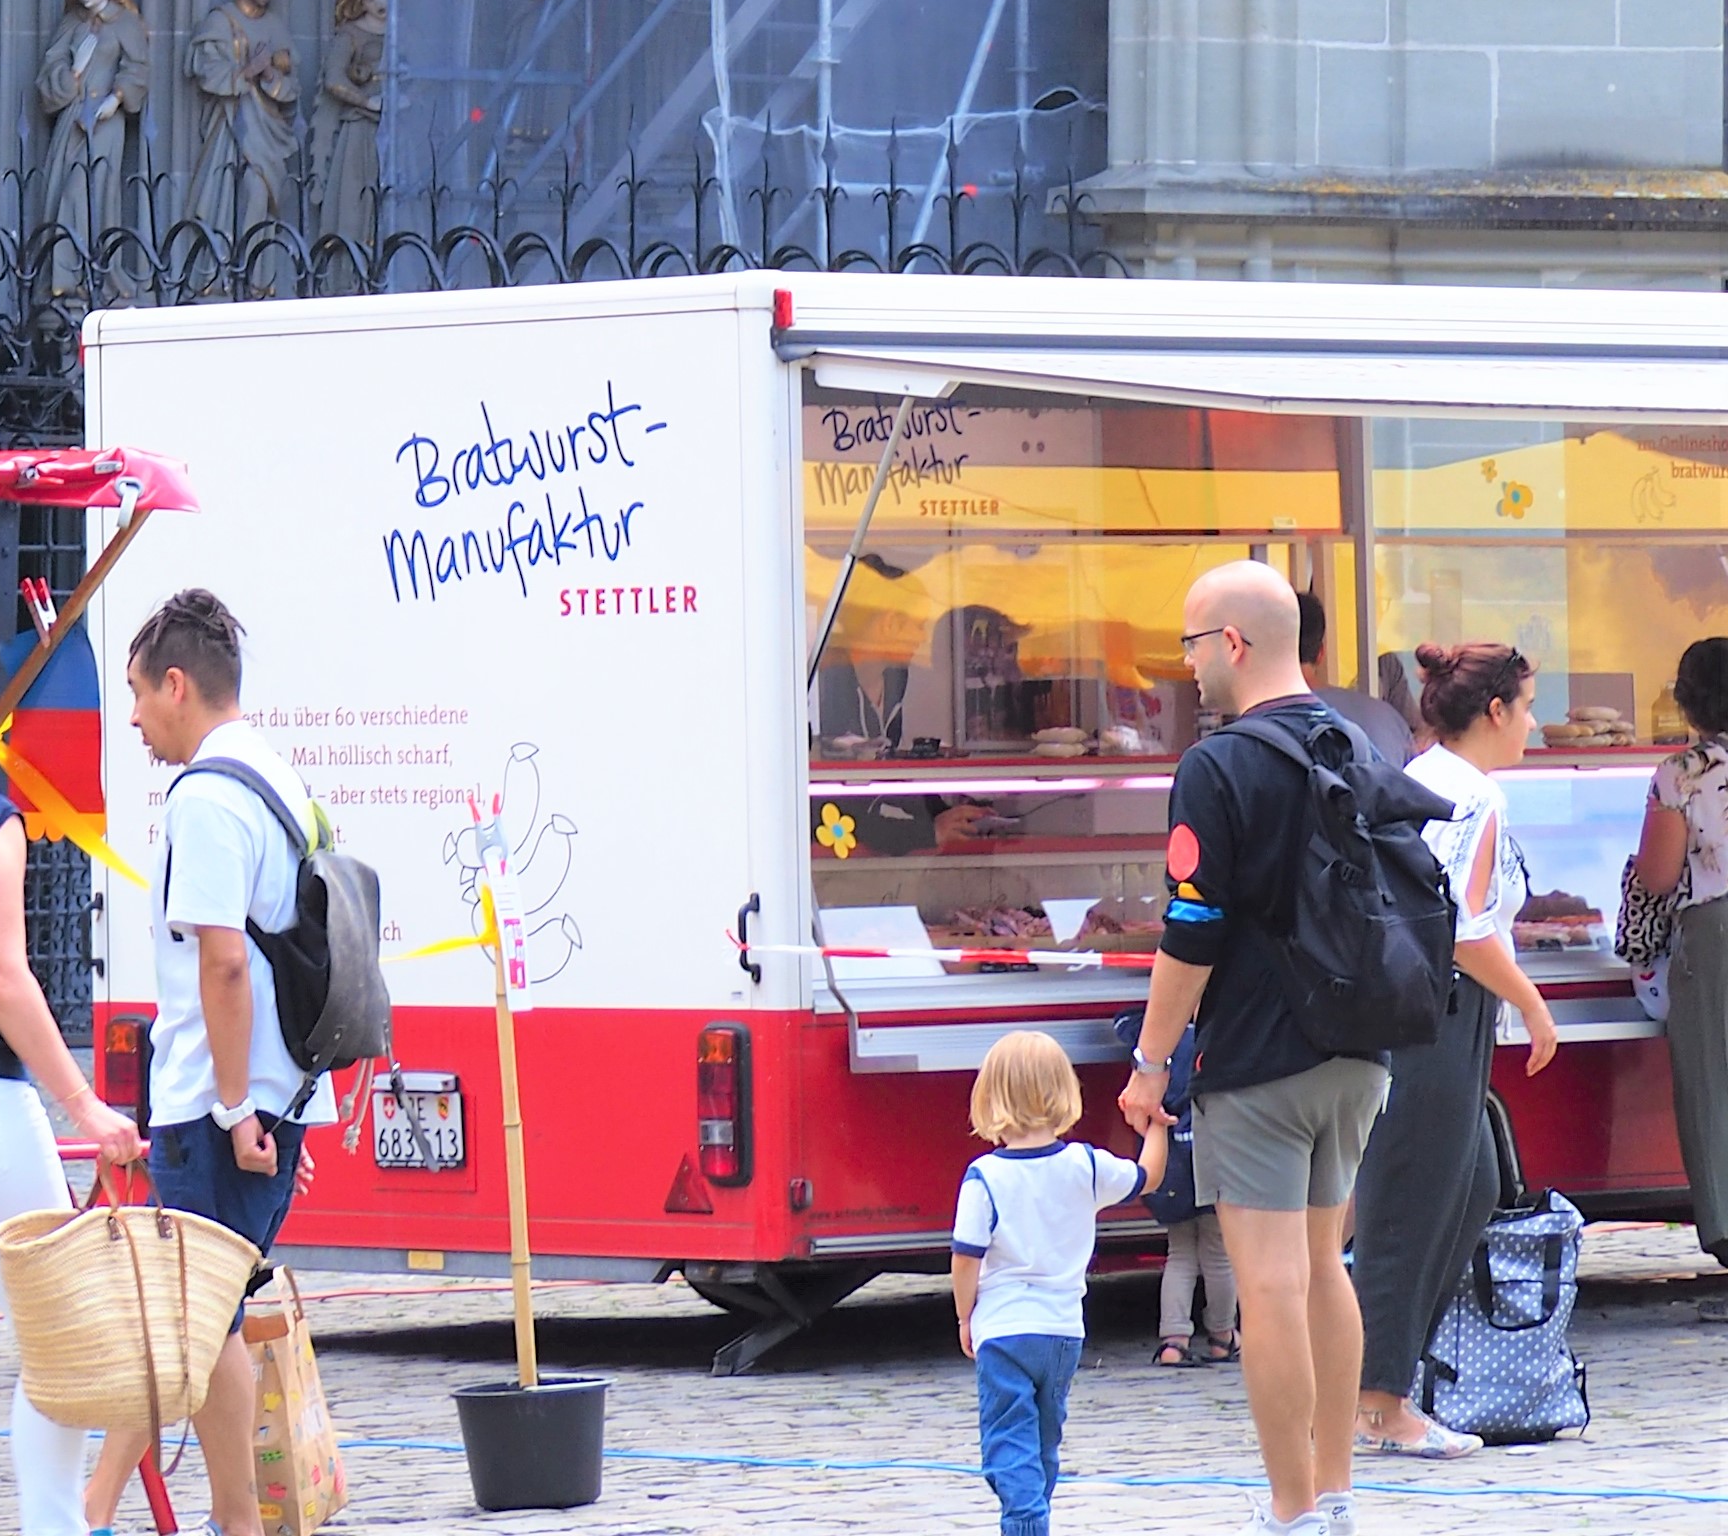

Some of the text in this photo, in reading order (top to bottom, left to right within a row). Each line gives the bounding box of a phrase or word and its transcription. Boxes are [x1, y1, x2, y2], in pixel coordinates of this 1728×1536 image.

[395, 379, 668, 508] Bratwurst-
[920, 499, 1000, 517] STETTLER
[382, 485, 645, 603] Manufaktur
[559, 584, 699, 617] STETTLER
[269, 707, 290, 727] du
[294, 707, 331, 727] über
[335, 709, 356, 727] 60
[360, 704, 469, 726] verschiedene
[291, 742, 454, 768] Mal höllisch scharf,
[330, 785, 365, 805] aber
[370, 785, 408, 804] stets
[413, 784, 487, 810] regional,
